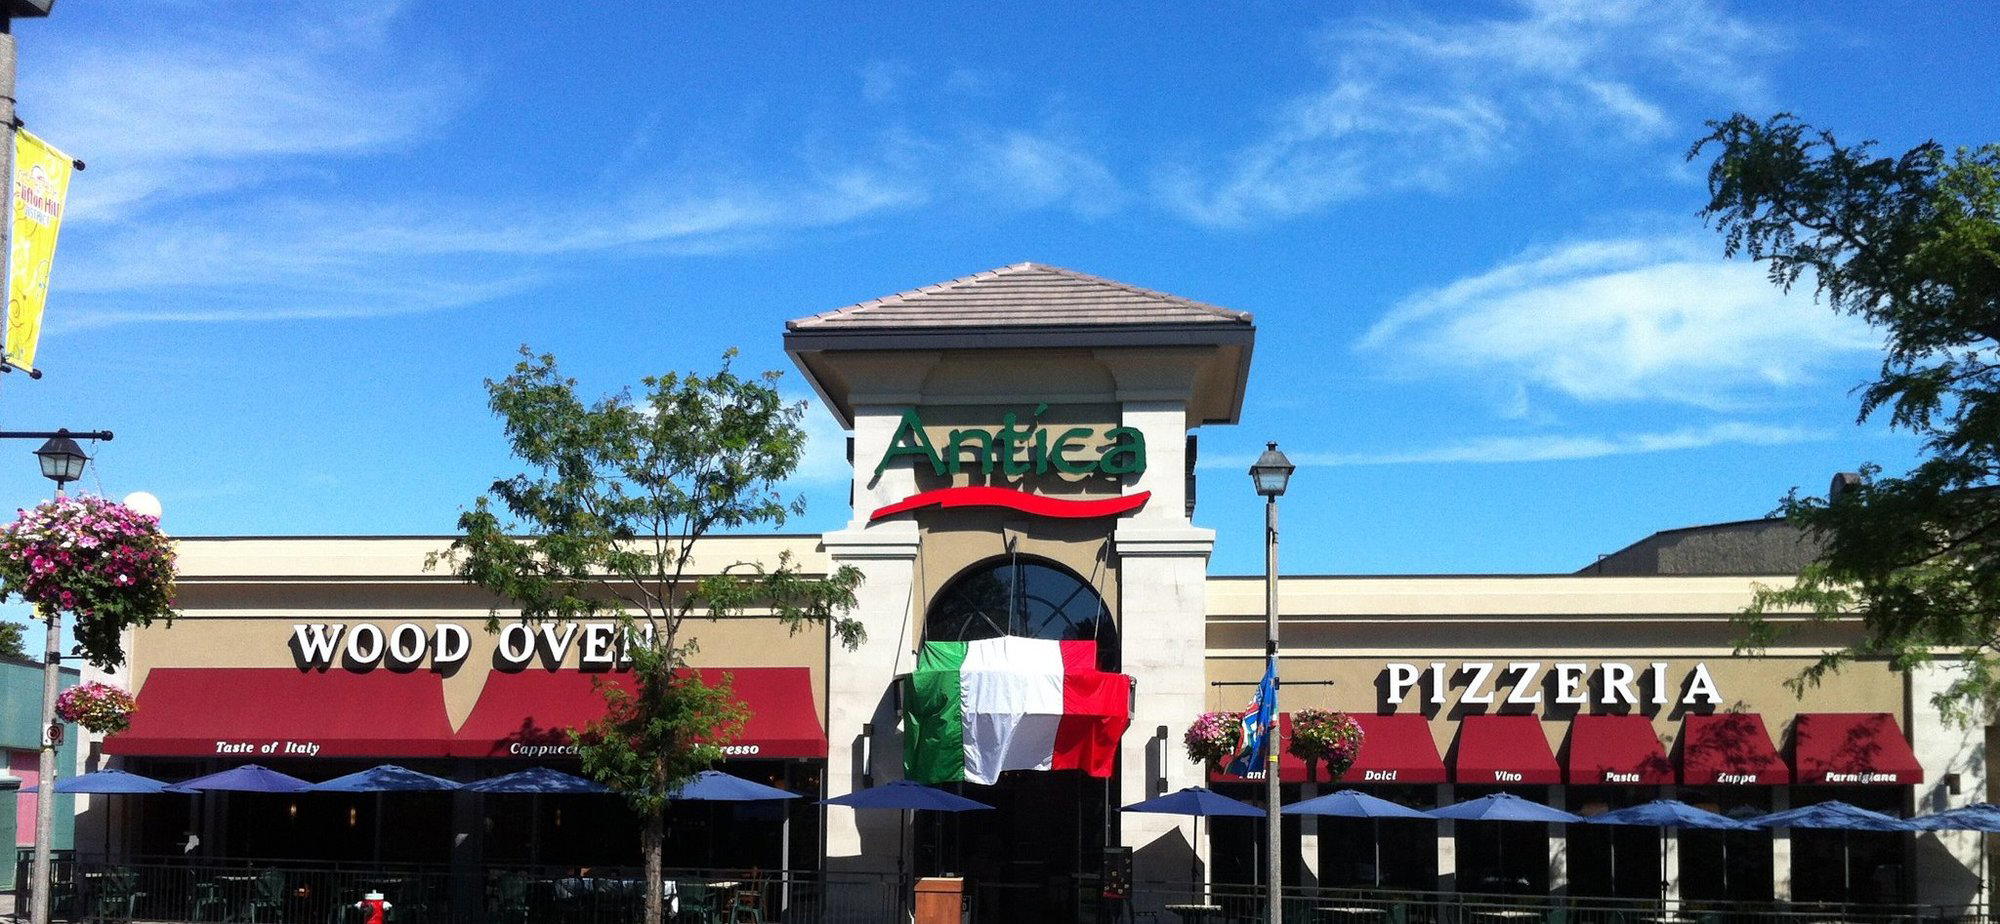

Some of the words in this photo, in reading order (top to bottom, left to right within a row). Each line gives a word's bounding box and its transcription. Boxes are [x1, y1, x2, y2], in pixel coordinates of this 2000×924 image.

[44, 197, 60, 218] Hill
[875, 403, 1147, 476] Antica
[293, 622, 471, 664] WOOD
[499, 622, 655, 663] OVEN
[1386, 661, 1724, 704] PIZZERIA
[216, 741, 255, 753] Taste
[261, 741, 279, 754] of
[284, 741, 320, 756] Italy
[510, 742, 581, 757] Cappucci
[1239, 769, 1266, 780] ani
[1364, 770, 1397, 781] Dolci
[1495, 770, 1523, 782] Vino
[1606, 772, 1640, 783] Pasta
[1717, 772, 1757, 785] Zuppa
[1825, 772, 1897, 784] Parmigiana
